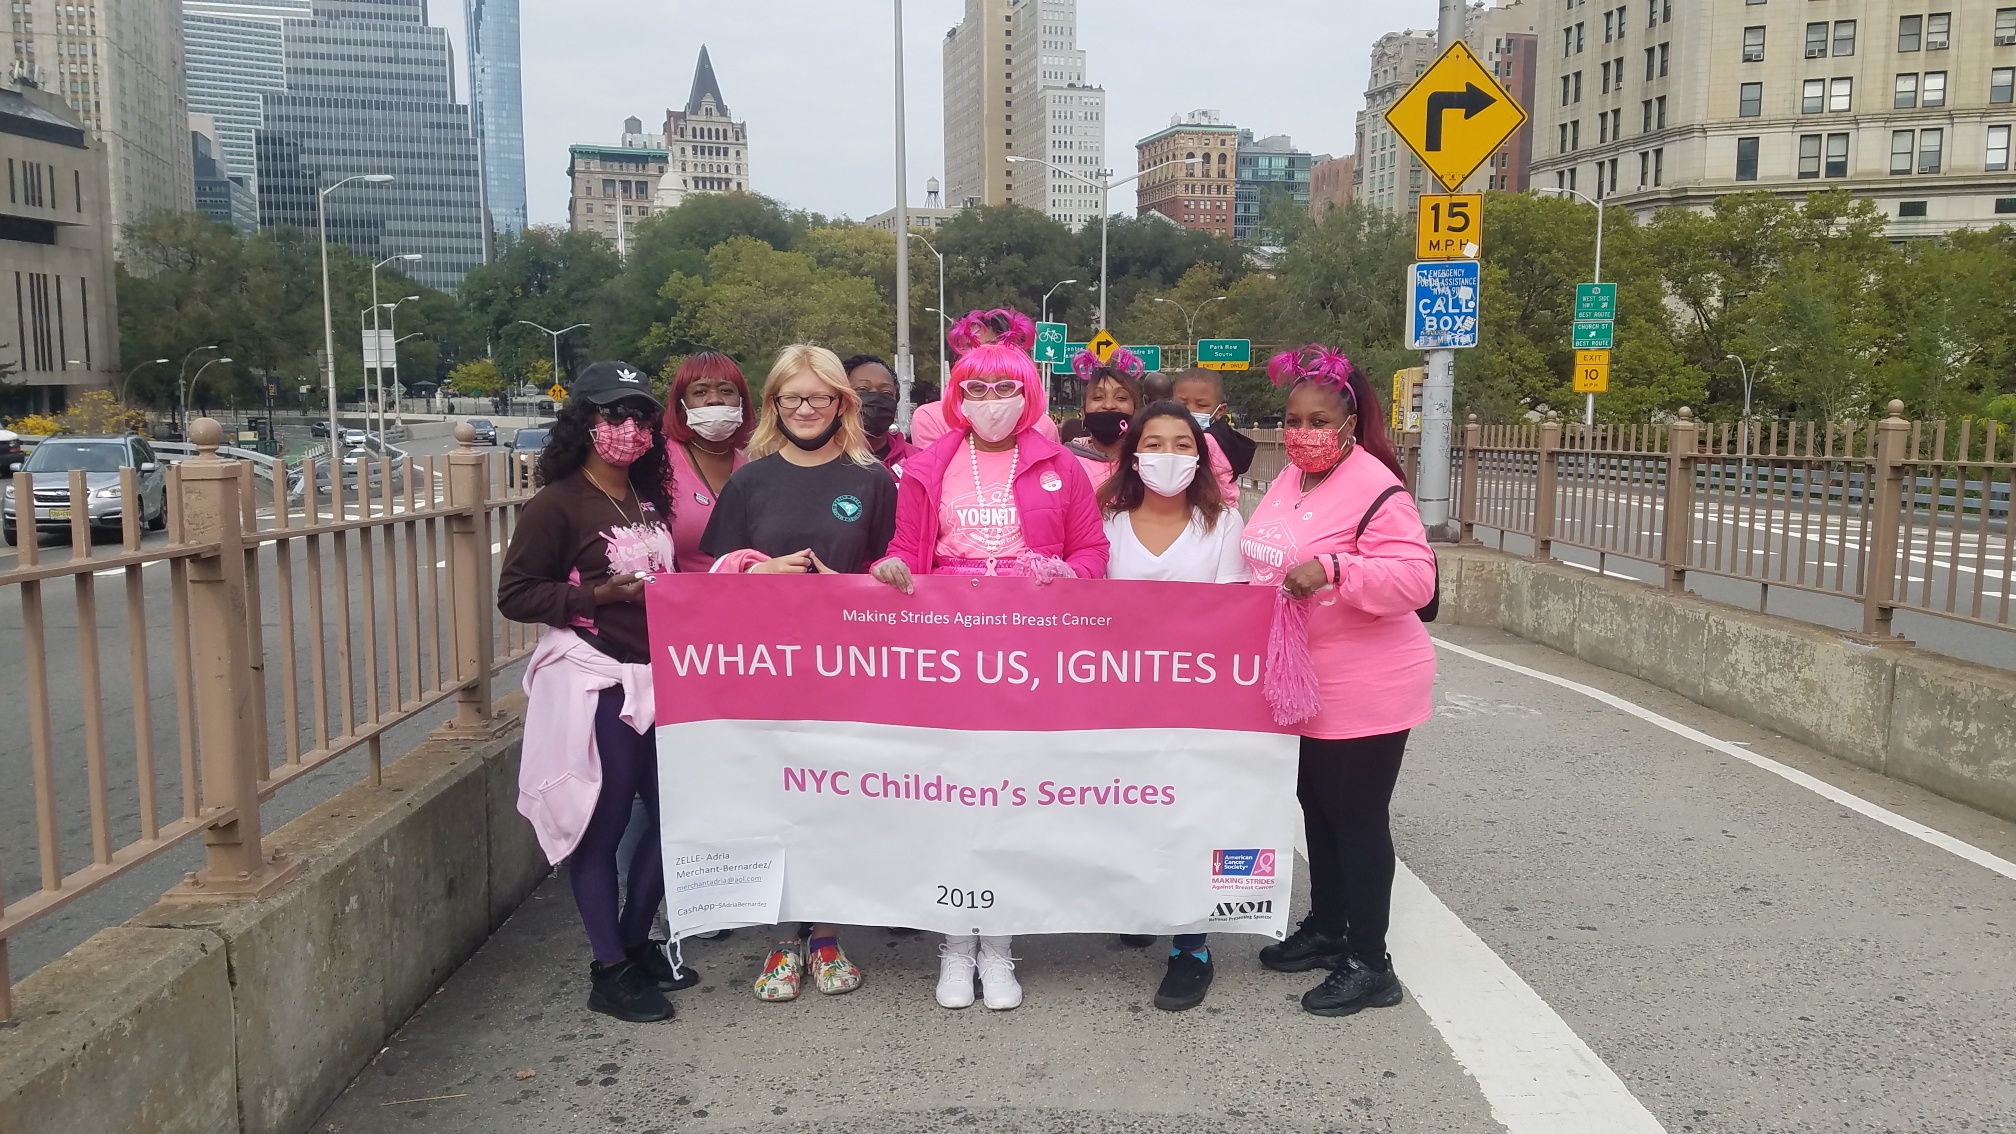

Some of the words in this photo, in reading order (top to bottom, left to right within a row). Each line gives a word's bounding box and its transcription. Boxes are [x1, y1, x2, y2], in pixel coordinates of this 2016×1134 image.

[1431, 202, 1470, 233] 15
[1429, 268, 1465, 278] EMERGENCY
[1441, 277, 1477, 287] ASSISTANCE
[1419, 297, 1474, 314] CALL
[1425, 315, 1465, 331] BOX
[1584, 368, 1599, 380] 10
[957, 507, 1020, 526] YOUNIT
[1240, 537, 1284, 568] YOUNITED
[843, 609, 897, 624] Making
[900, 609, 950, 625] Strides
[953, 611, 1008, 628] Against
[1012, 612, 1058, 626] Breast
[1061, 613, 1112, 626] Cancer
[667, 643, 801, 677] WHAT
[816, 644, 961, 683] UNITES
[976, 650, 1040, 691] US,
[1056, 650, 1217, 684] IGNITES
[1232, 653, 1269, 686] U
[782, 766, 850, 796] NYC
[859, 772, 1027, 807] Children's
[1037, 778, 1177, 807] Services
[675, 854, 704, 866] ZELLE-
[706, 852, 730, 861] Adria
[676, 860, 772, 879] Merchant-Bernardez/
[676, 876, 762, 893] merchantadria@aol.com
[936, 884, 995, 910] 2019
